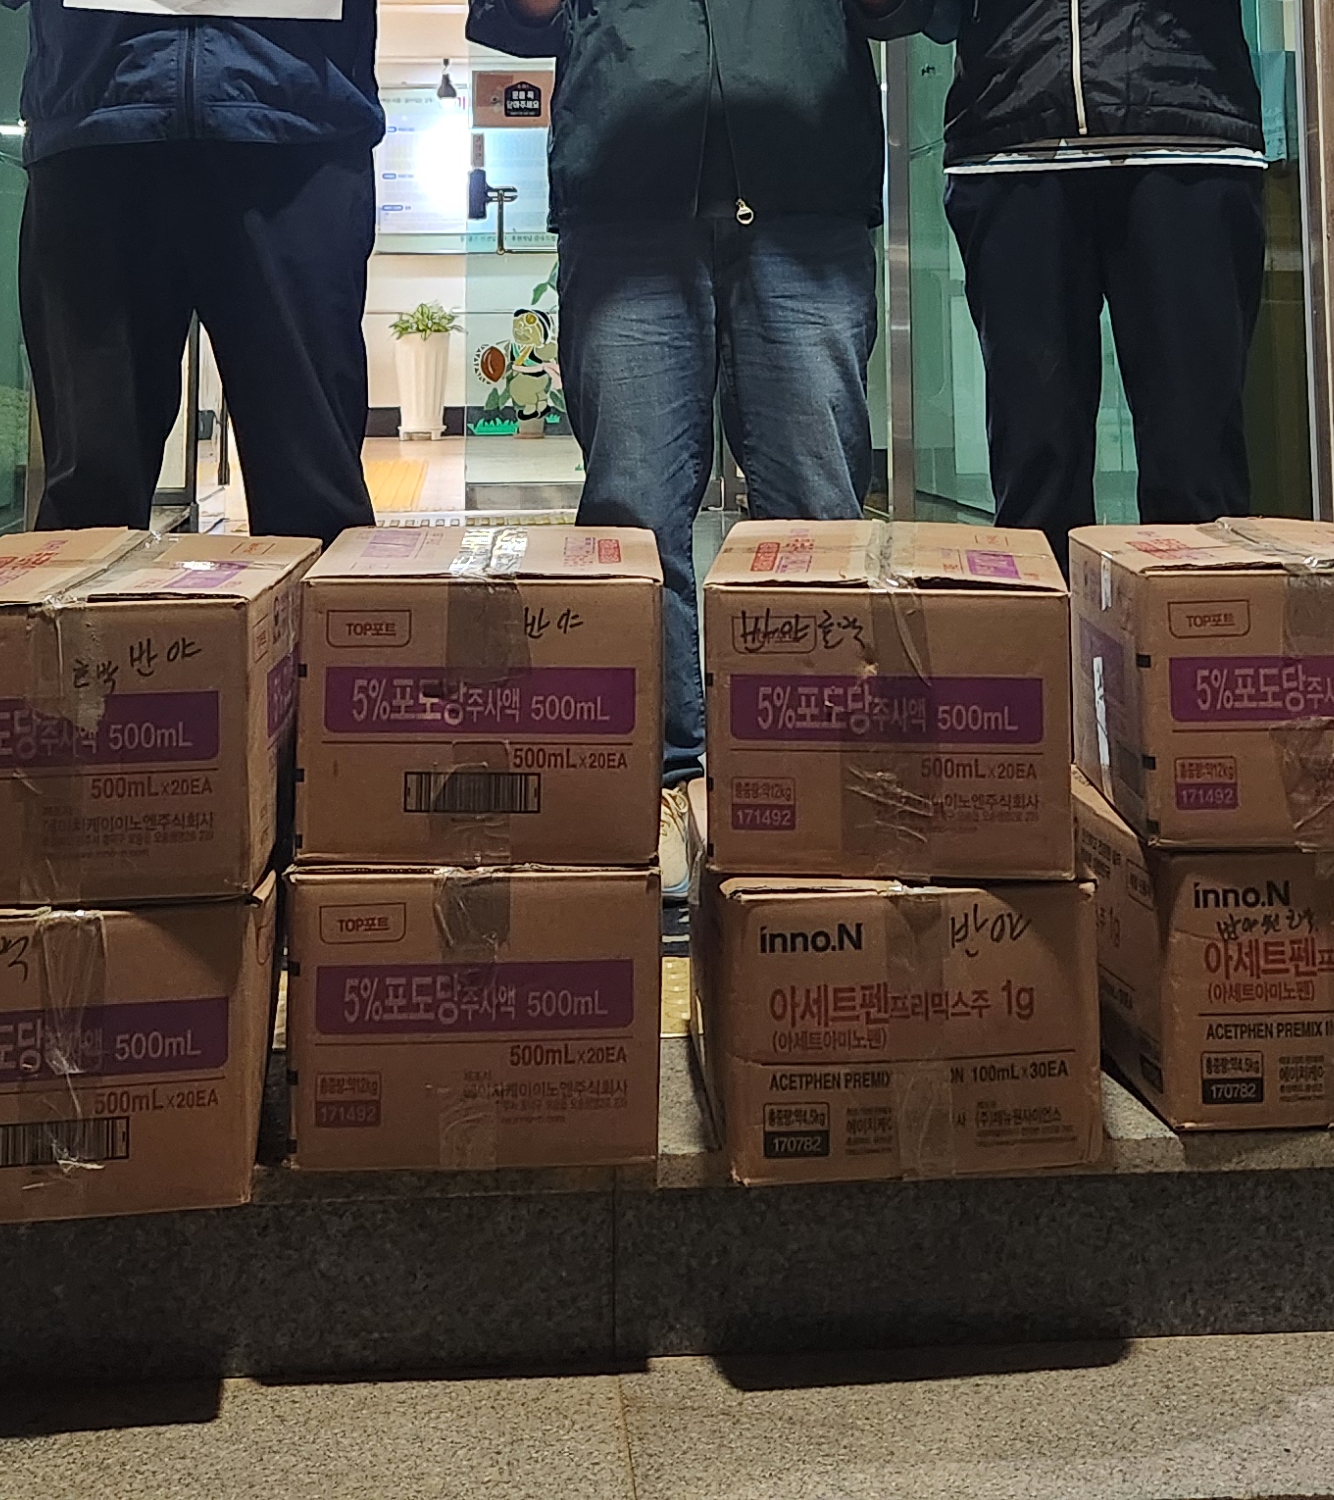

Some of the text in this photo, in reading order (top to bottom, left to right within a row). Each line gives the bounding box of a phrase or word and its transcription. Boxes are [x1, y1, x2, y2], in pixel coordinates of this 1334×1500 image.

[346, 622, 397, 637] TOP포트
[1185, 613, 1236, 628] TOP포트
[530, 695, 611, 722] 500mL
[936, 704, 1019, 732] 500mL
[108, 721, 194, 751] 500mL
[1180, 788, 1234, 805] 171492
[736, 810, 792, 826] 171492
[1193, 880, 1290, 909] inno.N
[338, 916, 391, 932] TOP포트
[759, 922, 864, 954] inno.N
[344, 972, 609, 1024] 5%포도당주사액 500mL
[1208, 981, 1315, 1003] (아세트아미노펜)
[769, 979, 1035, 1028] 아세트펜프리믹스주 1g
[1206, 1021, 1273, 1040] ACETPHEN
[1277, 1020, 1323, 1038] PREMIX
[115, 1030, 202, 1061] 500mL
[772, 1029, 888, 1054] (아세트아미노펜)
[769, 1071, 841, 1092] ACETPHEN
[1210, 1083, 1257, 1099] 170782
[320, 1105, 377, 1123] 171492
[773, 1136, 822, 1153] 170782
